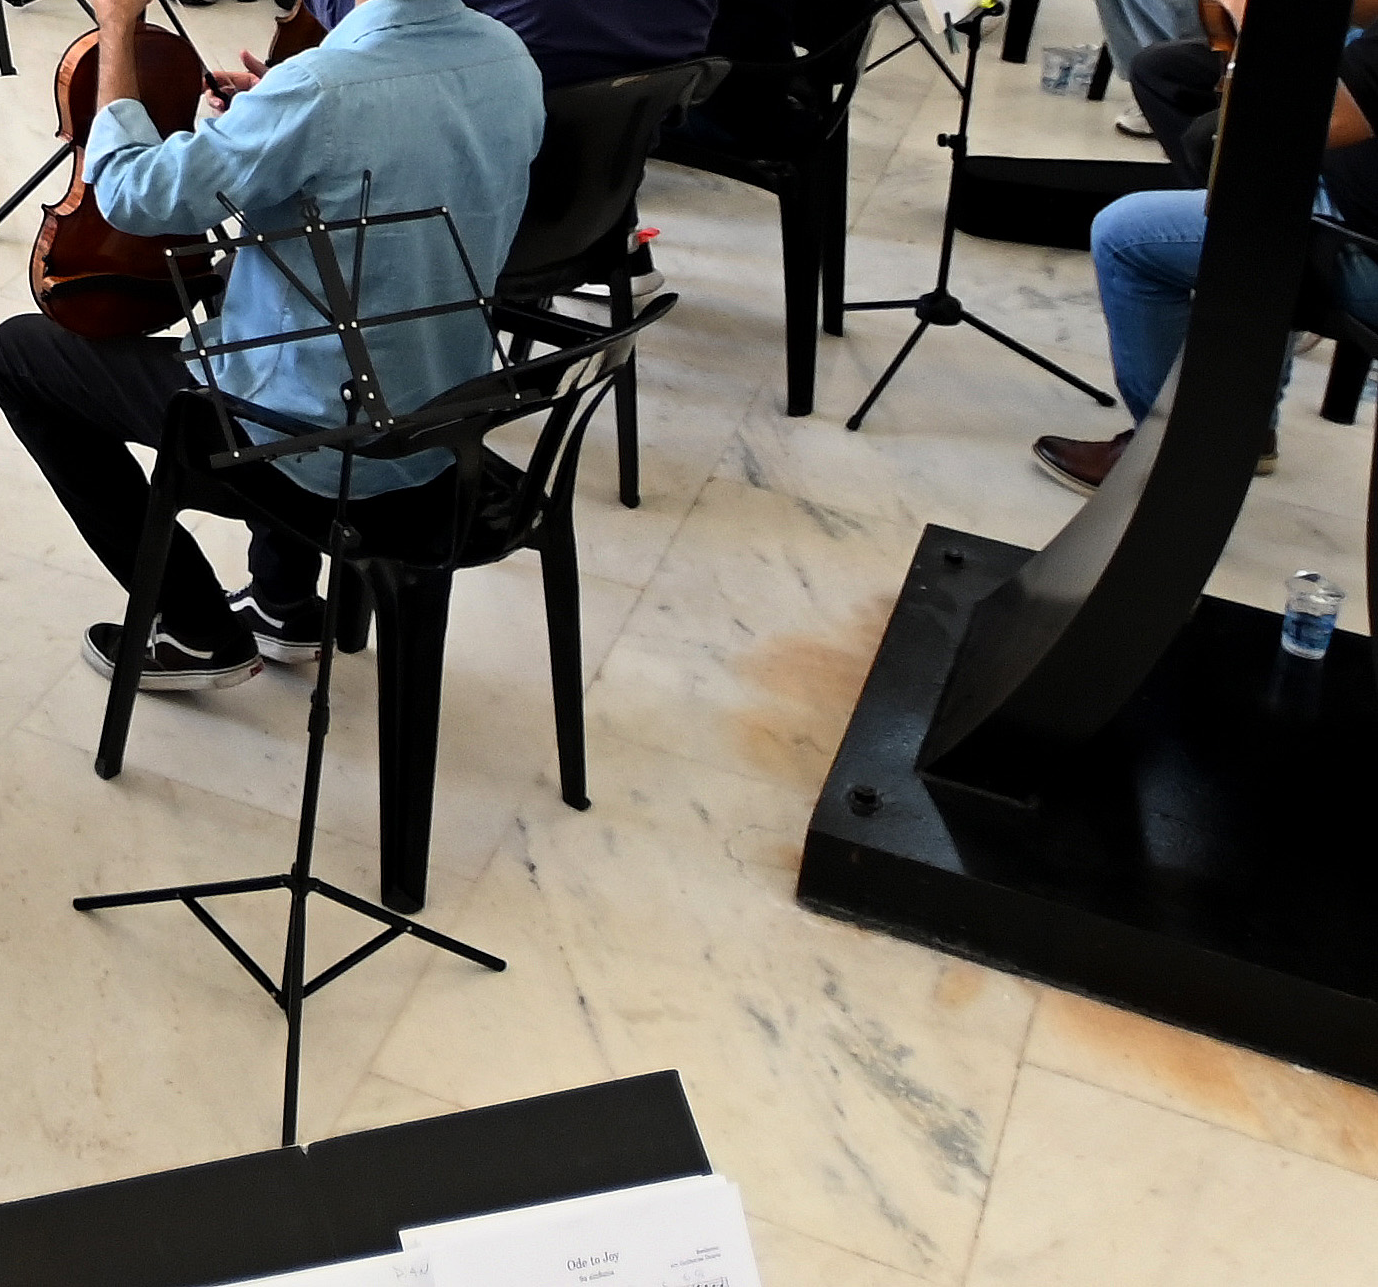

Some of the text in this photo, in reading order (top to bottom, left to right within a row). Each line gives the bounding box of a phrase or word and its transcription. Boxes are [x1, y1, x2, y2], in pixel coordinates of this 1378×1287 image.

[567, 1251, 620, 1271] Ode to Joy
